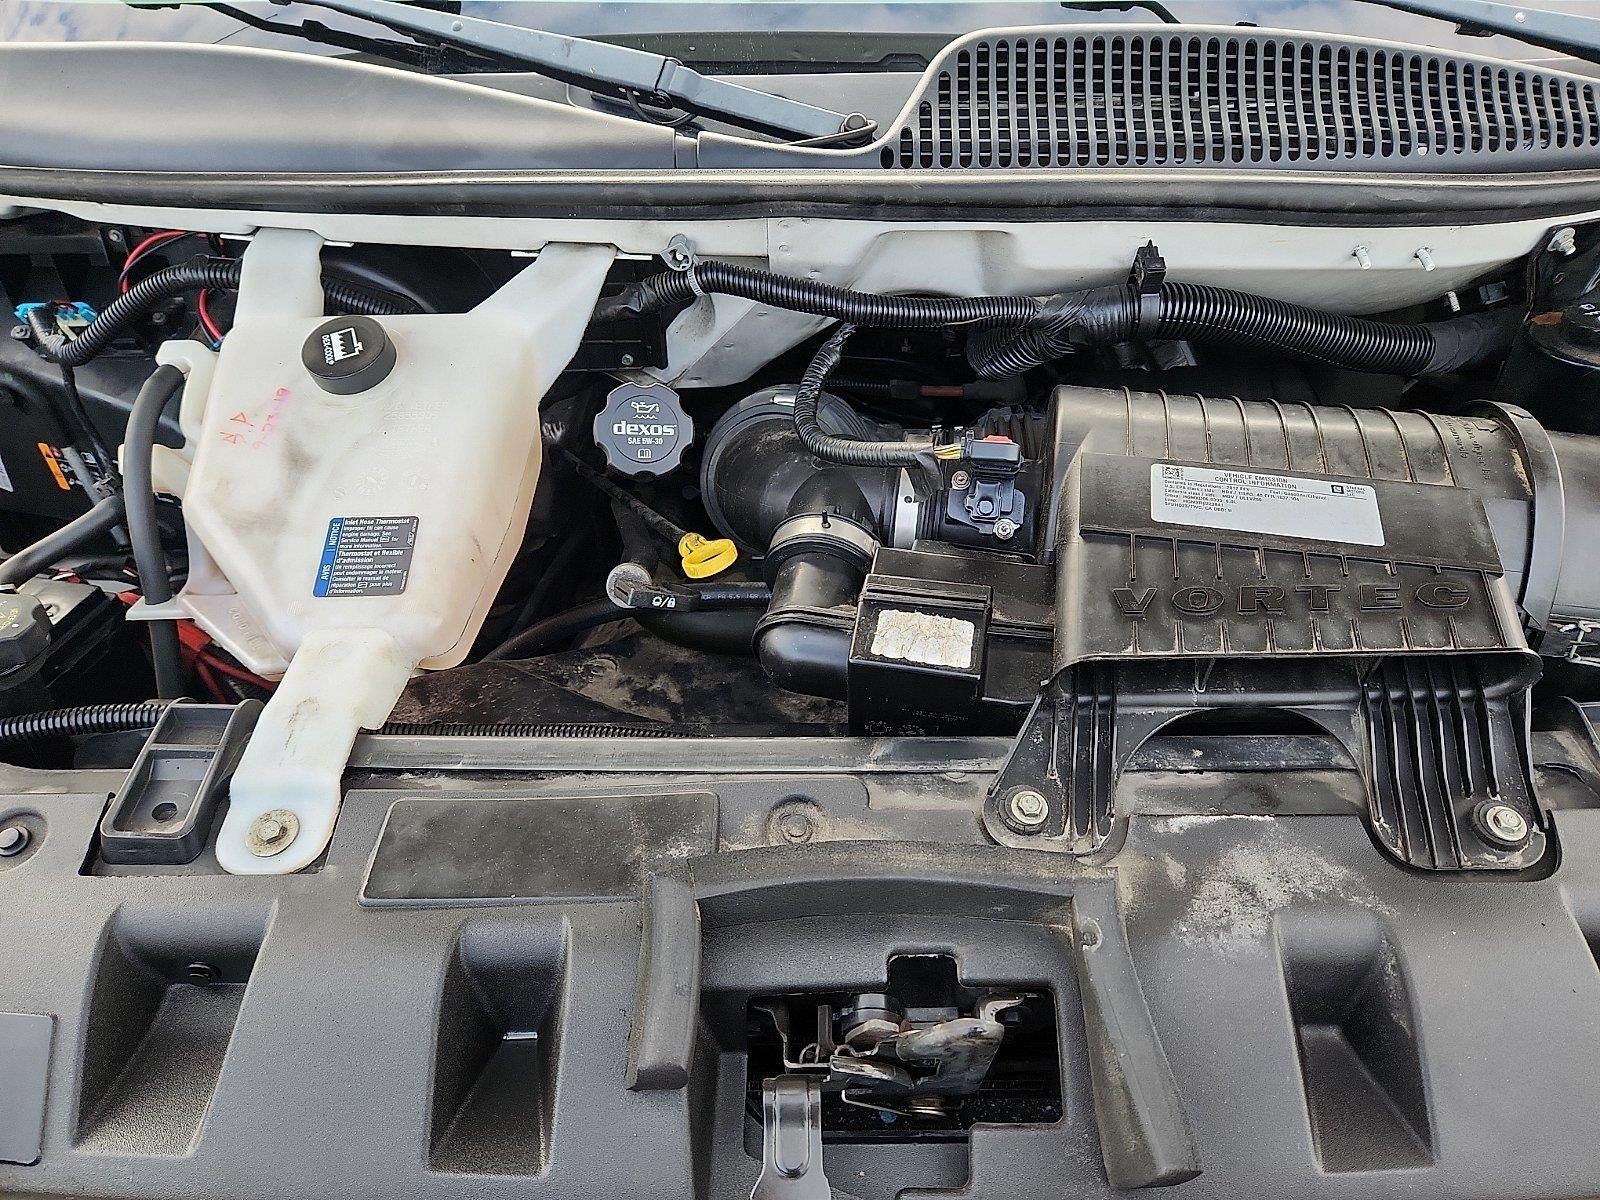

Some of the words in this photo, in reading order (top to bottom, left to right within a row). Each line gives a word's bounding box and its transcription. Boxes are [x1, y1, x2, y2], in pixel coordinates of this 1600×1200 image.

[613, 421, 677, 436] dexos
[1214, 476, 1248, 485] CONTROL
[1248, 480, 1297, 490] INFORMATION
[1223, 472, 1253, 481] VEHICLE
[1254, 475, 1288, 484] EMISSION
[329, 522, 341, 546] NOTICE
[320, 564, 331, 580] AVIS
[1112, 583, 1471, 616] VORTEC
